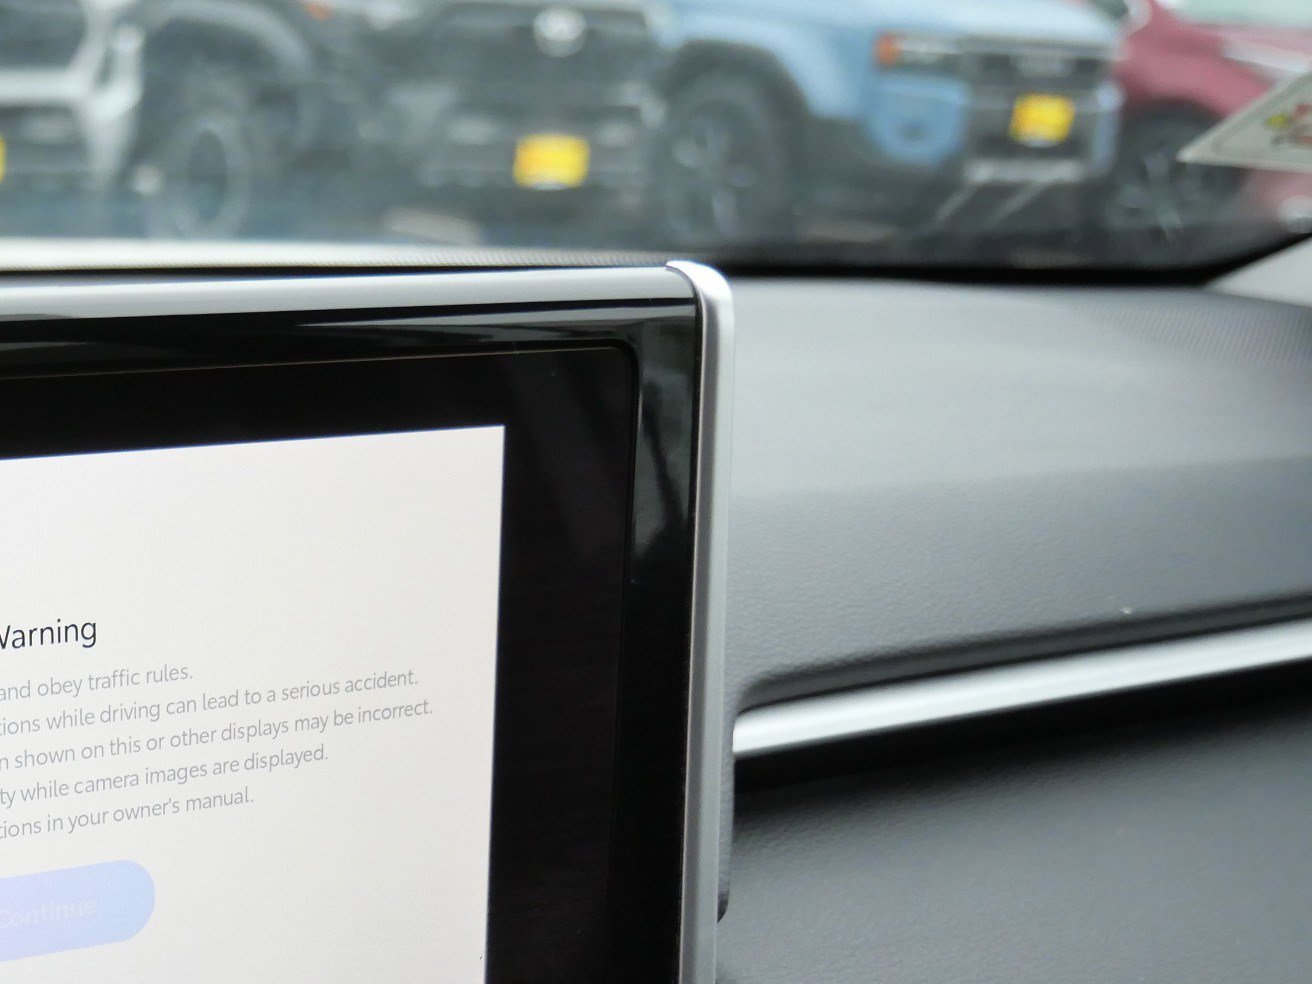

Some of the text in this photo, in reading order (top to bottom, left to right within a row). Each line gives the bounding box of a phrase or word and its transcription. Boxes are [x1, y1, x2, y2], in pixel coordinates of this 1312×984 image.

[36, 676, 83, 698] obey
[87, 668, 140, 691] traffic
[145, 663, 193, 684] rules.
[45, 707, 96, 730] while
[99, 701, 161, 724] driving
[165, 699, 197, 716] can
[202, 689, 239, 711] lead
[243, 689, 262, 706] to
[266, 689, 277, 703] a
[281, 680, 341, 701] serious
[344, 669, 418, 694] accident.
[14, 748, 76, 769] shown
[80, 744, 105, 760] on
[109, 735, 142, 756] this
[145, 736, 165, 751] or
[169, 728, 217, 748] other
[220, 719, 290, 743] displays
[294, 715, 330, 734] may
[333, 709, 354, 727] be
[357, 699, 435, 724] incorrect.
[19, 779, 70, 802] while
[73, 773, 140, 795] camera
[145, 763, 208, 786] images
[212, 759, 240, 776] are
[243, 743, 329, 773] displayed.
[47, 814, 64, 832] in
[67, 810, 109, 835] your
[112, 797, 180, 823] owner's
[185, 785, 254, 812] manual.
